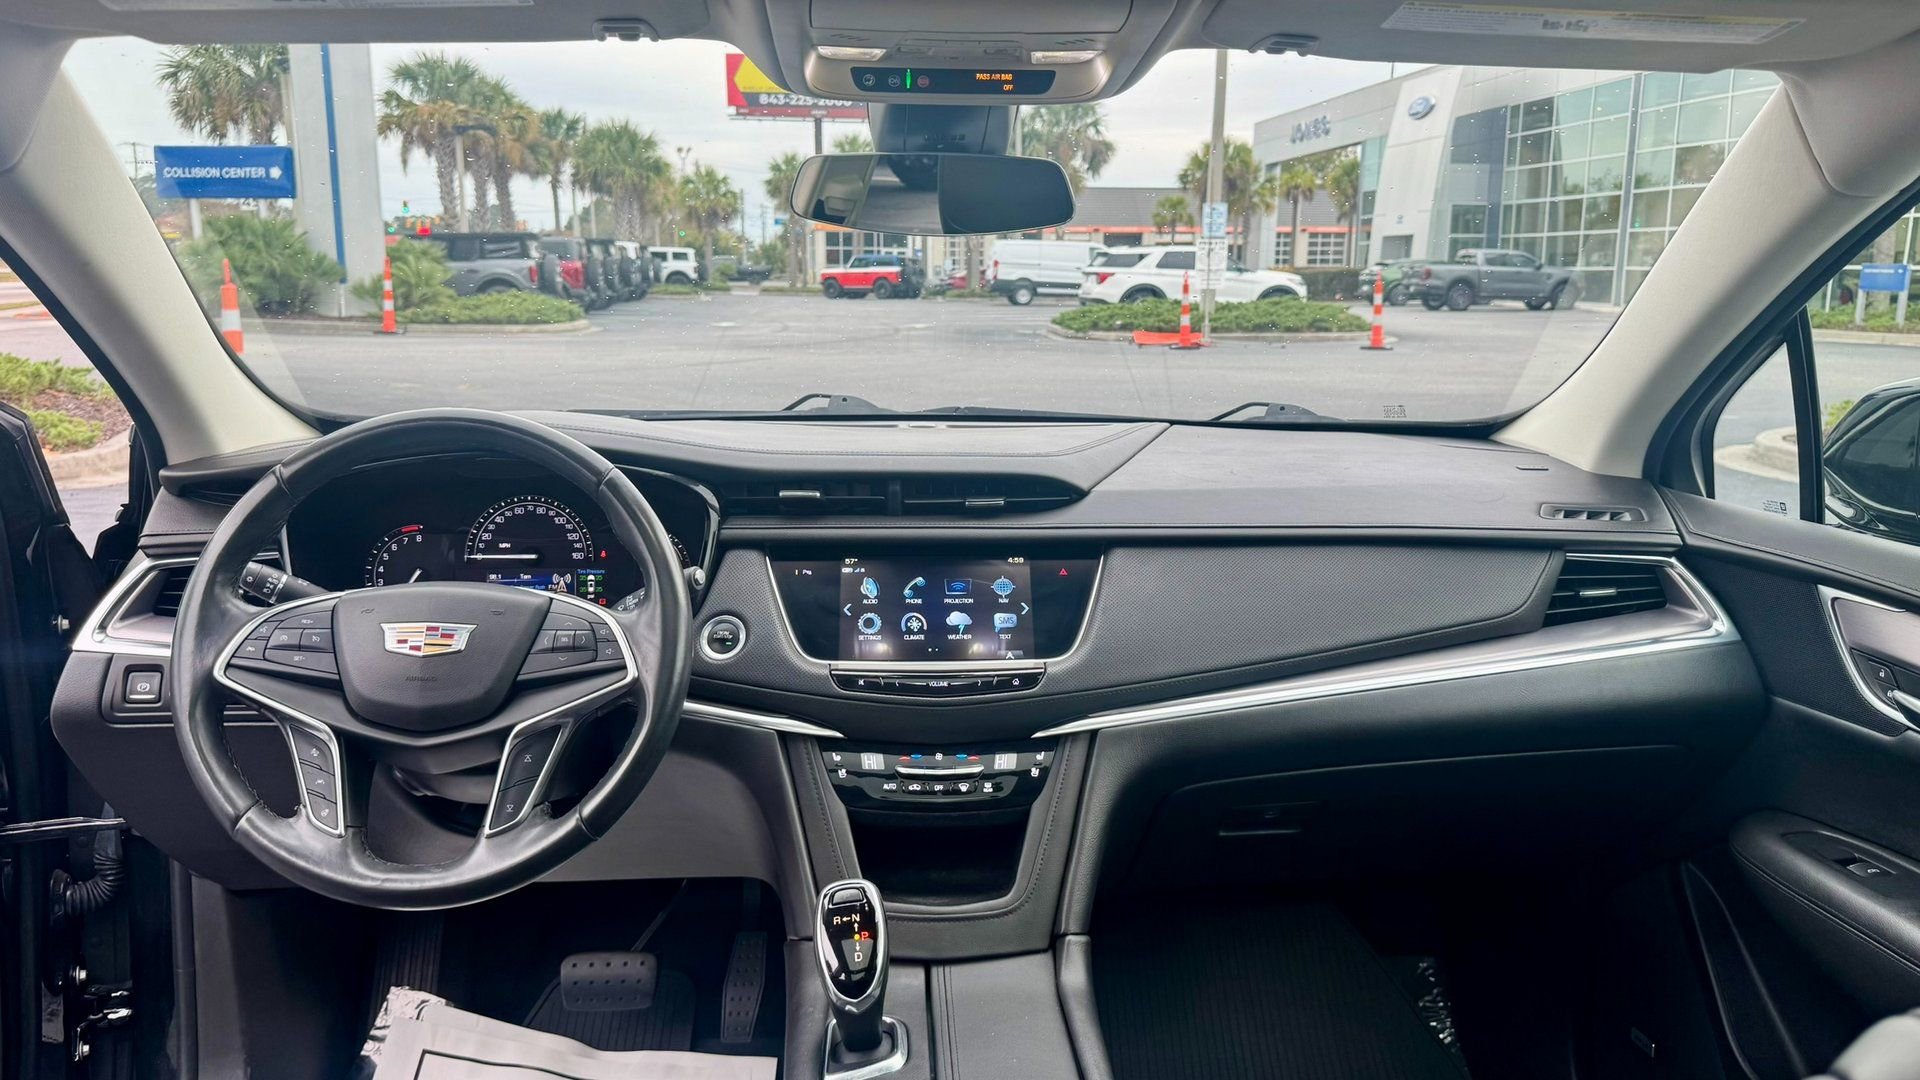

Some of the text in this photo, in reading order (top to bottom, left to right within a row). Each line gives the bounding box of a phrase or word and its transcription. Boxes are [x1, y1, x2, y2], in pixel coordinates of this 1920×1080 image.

[976, 73, 1013, 81] PASS AIR BAG
[163, 166, 266, 178] COLLISION CENTER
[402, 537, 409, 545] 7
[391, 543, 398, 551] 6
[383, 553, 389, 561] 5
[572, 552, 584, 560] 160
[378, 565, 384, 573] 4
[377, 578, 384, 586] 3
[998, 616, 1015, 624] SMS
[833, 913, 860, 925] R N
[861, 931, 869, 941] P
[854, 952, 863, 962] D
